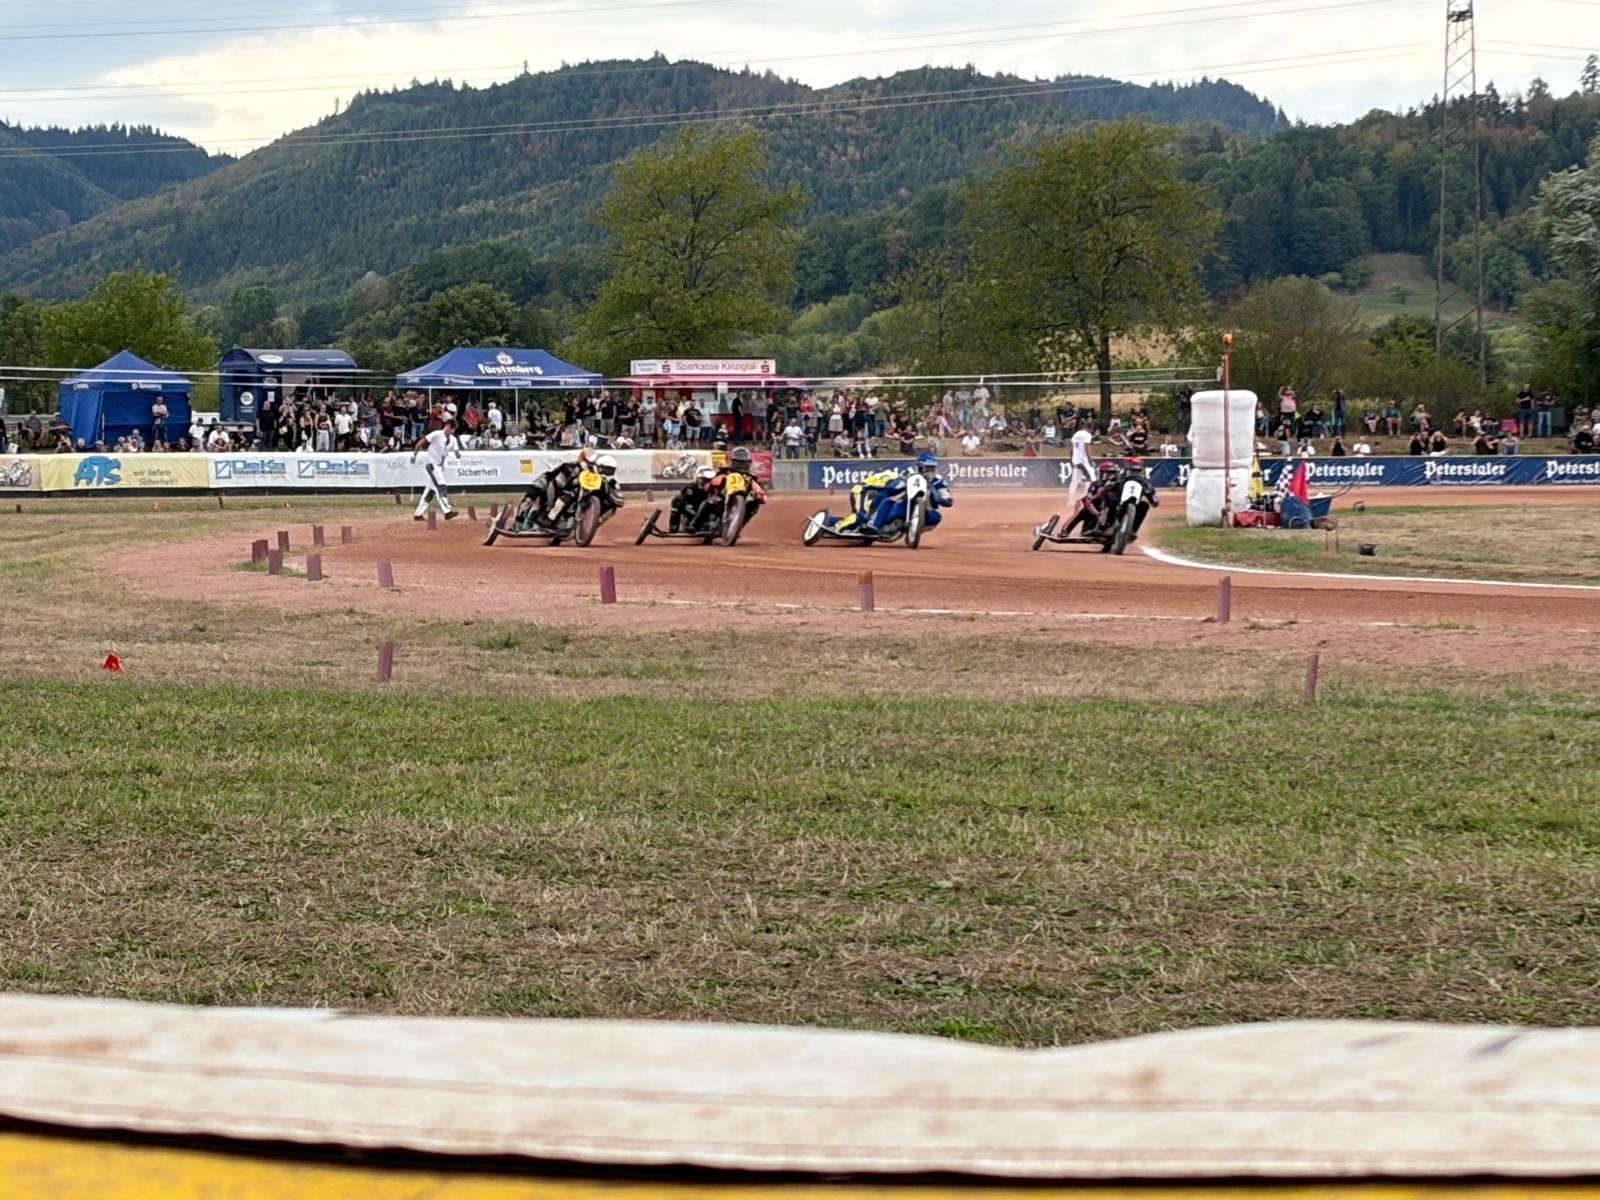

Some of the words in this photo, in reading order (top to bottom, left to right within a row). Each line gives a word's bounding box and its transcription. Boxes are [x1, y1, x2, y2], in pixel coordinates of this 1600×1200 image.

[676, 361, 719, 371] Sparkasse
[721, 361, 756, 372] Kinzigtal
[457, 467, 498, 477] Sicherheit
[947, 463, 1028, 483] Peterstaler
[1305, 461, 1385, 481] Peterstaler
[1424, 460, 1506, 480] Peterstaler
